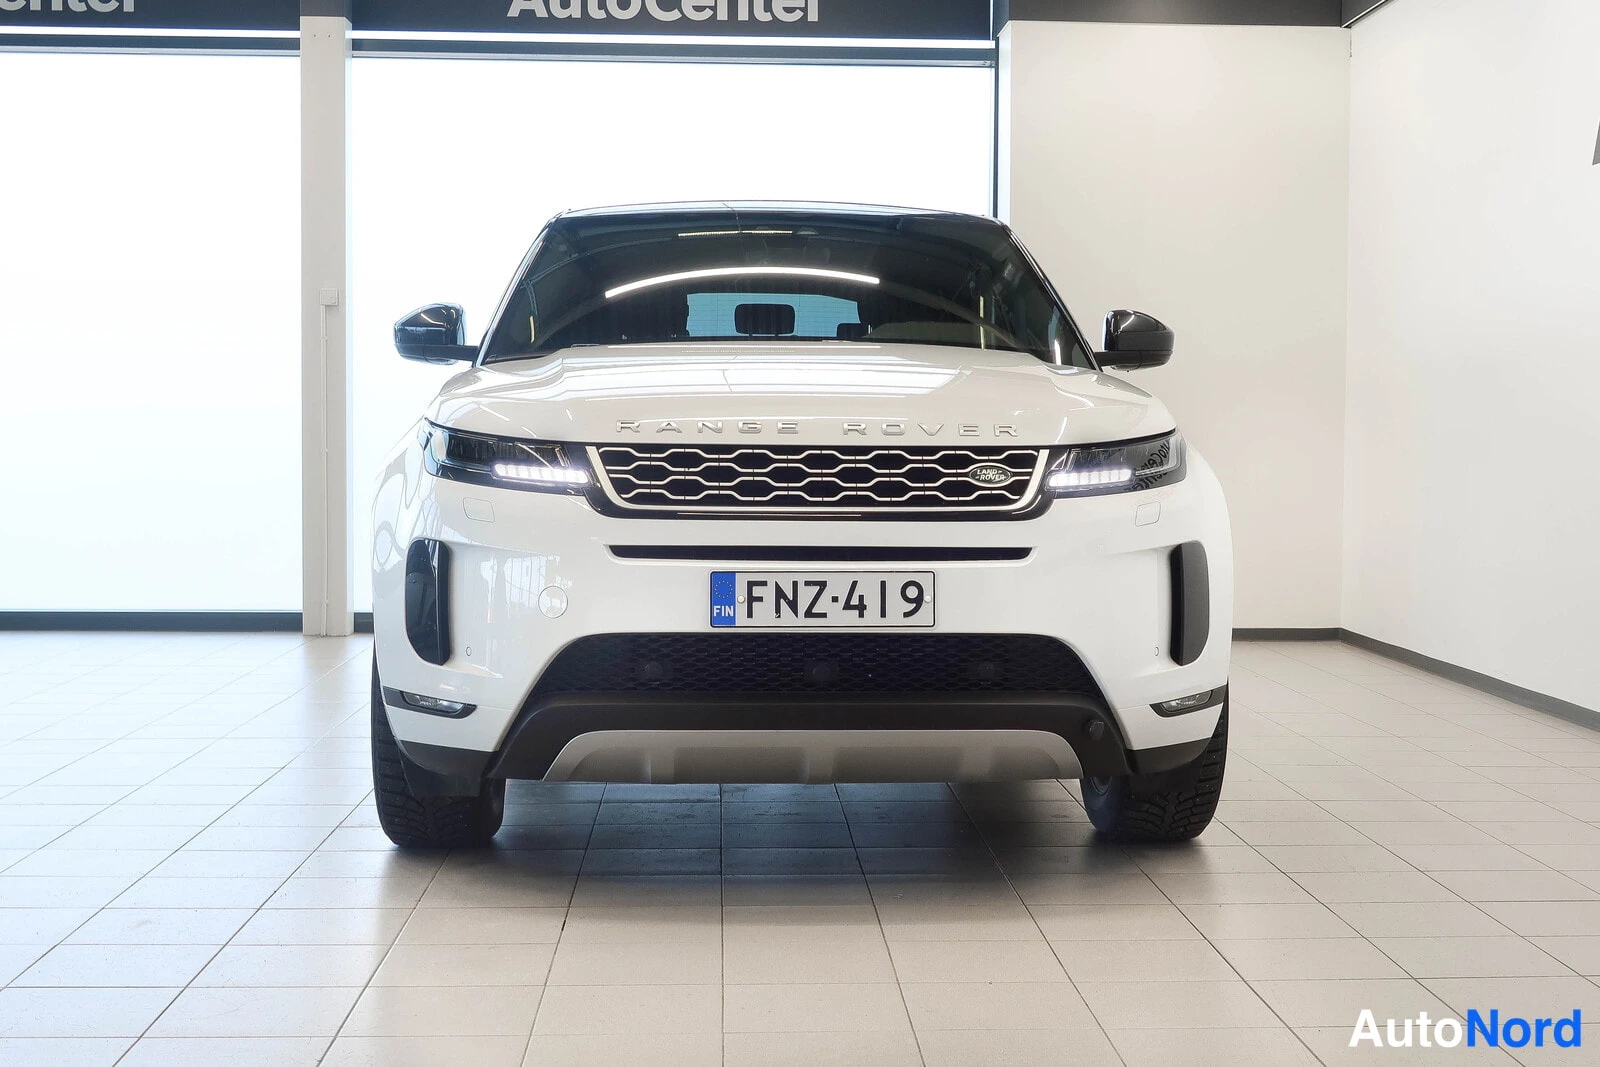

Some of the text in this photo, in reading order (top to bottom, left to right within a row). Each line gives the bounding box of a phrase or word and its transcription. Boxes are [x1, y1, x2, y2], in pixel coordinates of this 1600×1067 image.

[616, 419, 1018, 437] RANGE ROVER
[713, 605, 734, 617] FIN
